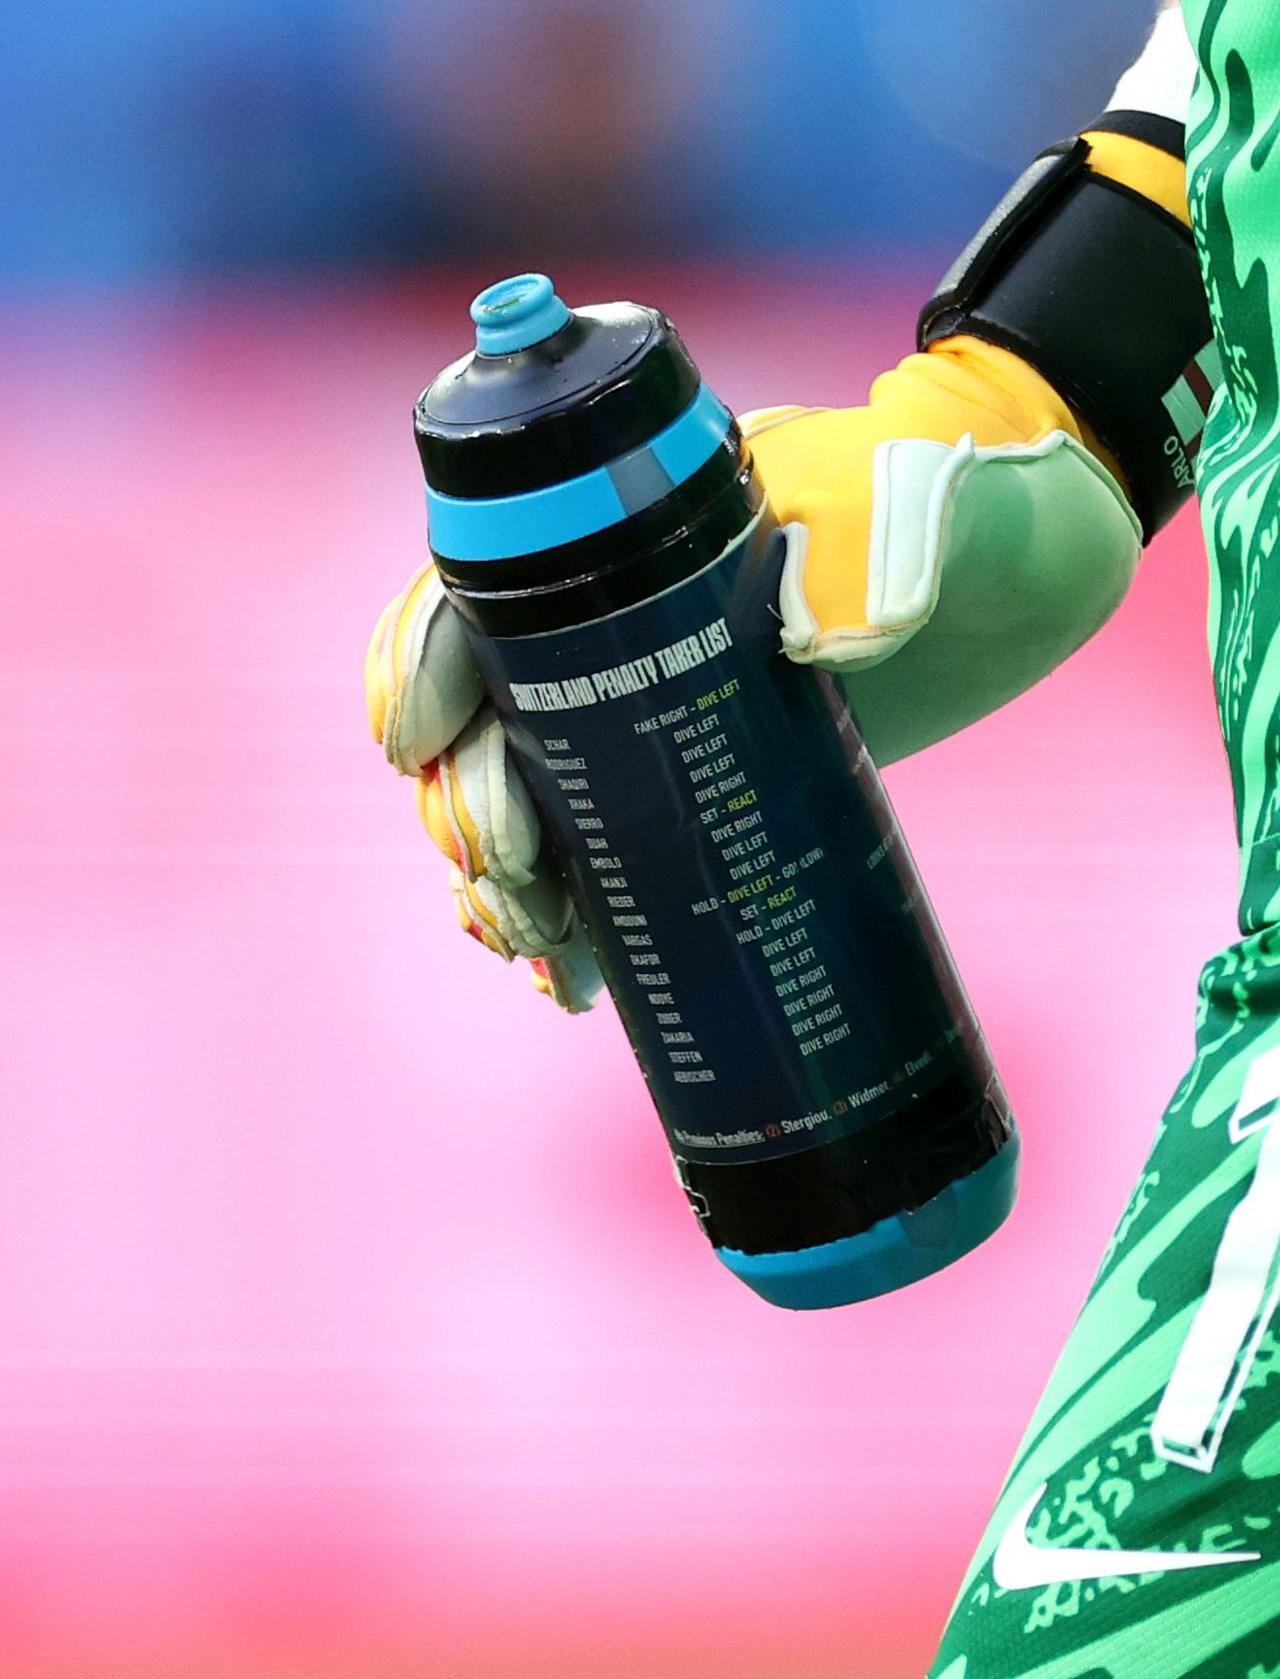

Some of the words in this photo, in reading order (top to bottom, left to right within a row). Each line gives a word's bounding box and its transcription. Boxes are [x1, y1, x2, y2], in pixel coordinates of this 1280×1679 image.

[1163, 435, 1195, 490] ARLO
[509, 676, 598, 711] SWITZERLAND
[591, 655, 659, 702] PENALTY
[654, 634, 706, 680] TAKER
[698, 617, 734, 661] LIST
[634, 717, 660, 734] FAKE
[658, 706, 688, 725] RIGHT
[696, 690, 719, 710] DIVE
[718, 678, 740, 699] LEFT
[674, 725, 698, 743] DIVE
[696, 713, 720, 734] LEFT
[681, 744, 706, 763] DIVE
[705, 733, 728, 754] LEFT
[690, 764, 714, 783] DIVE
[712, 753, 735, 773] LEFT
[695, 784, 719, 804] DIVE
[718, 771, 746, 794] RIGHT
[700, 807, 718, 824] SET
[727, 789, 757, 812] REACT
[711, 824, 736, 843] DIVE
[734, 810, 762, 832] RIGHT
[722, 842, 746, 861] DIVE
[744, 831, 768, 851] LEFT
[590, 857, 622, 869] EMBOLO
[730, 861, 754, 880] DIVE
[752, 850, 776, 870] LEFT
[691, 897, 718, 915] HOLD
[727, 885, 750, 902] DIVE
[750, 874, 773, 892] LEFT
[740, 904, 759, 920] SET
[767, 886, 796, 909] REACT
[736, 926, 763, 944] HOLD
[771, 910, 795, 930] DIVE
[794, 899, 816, 919] LEFT
[762, 938, 786, 957] DIVE
[785, 927, 808, 947] LEFT
[770, 958, 794, 976] DIVE
[793, 946, 816, 966] LEFT
[775, 978, 799, 996] DIVE
[798, 965, 826, 987] RIGHT
[782, 998, 807, 1016] DIVE
[806, 984, 834, 1006] RIGHT
[792, 1017, 815, 1036] DIVE
[815, 1004, 842, 1026] RIGHT
[800, 1037, 824, 1056] DIVE
[823, 1022, 850, 1046] RIGHT
